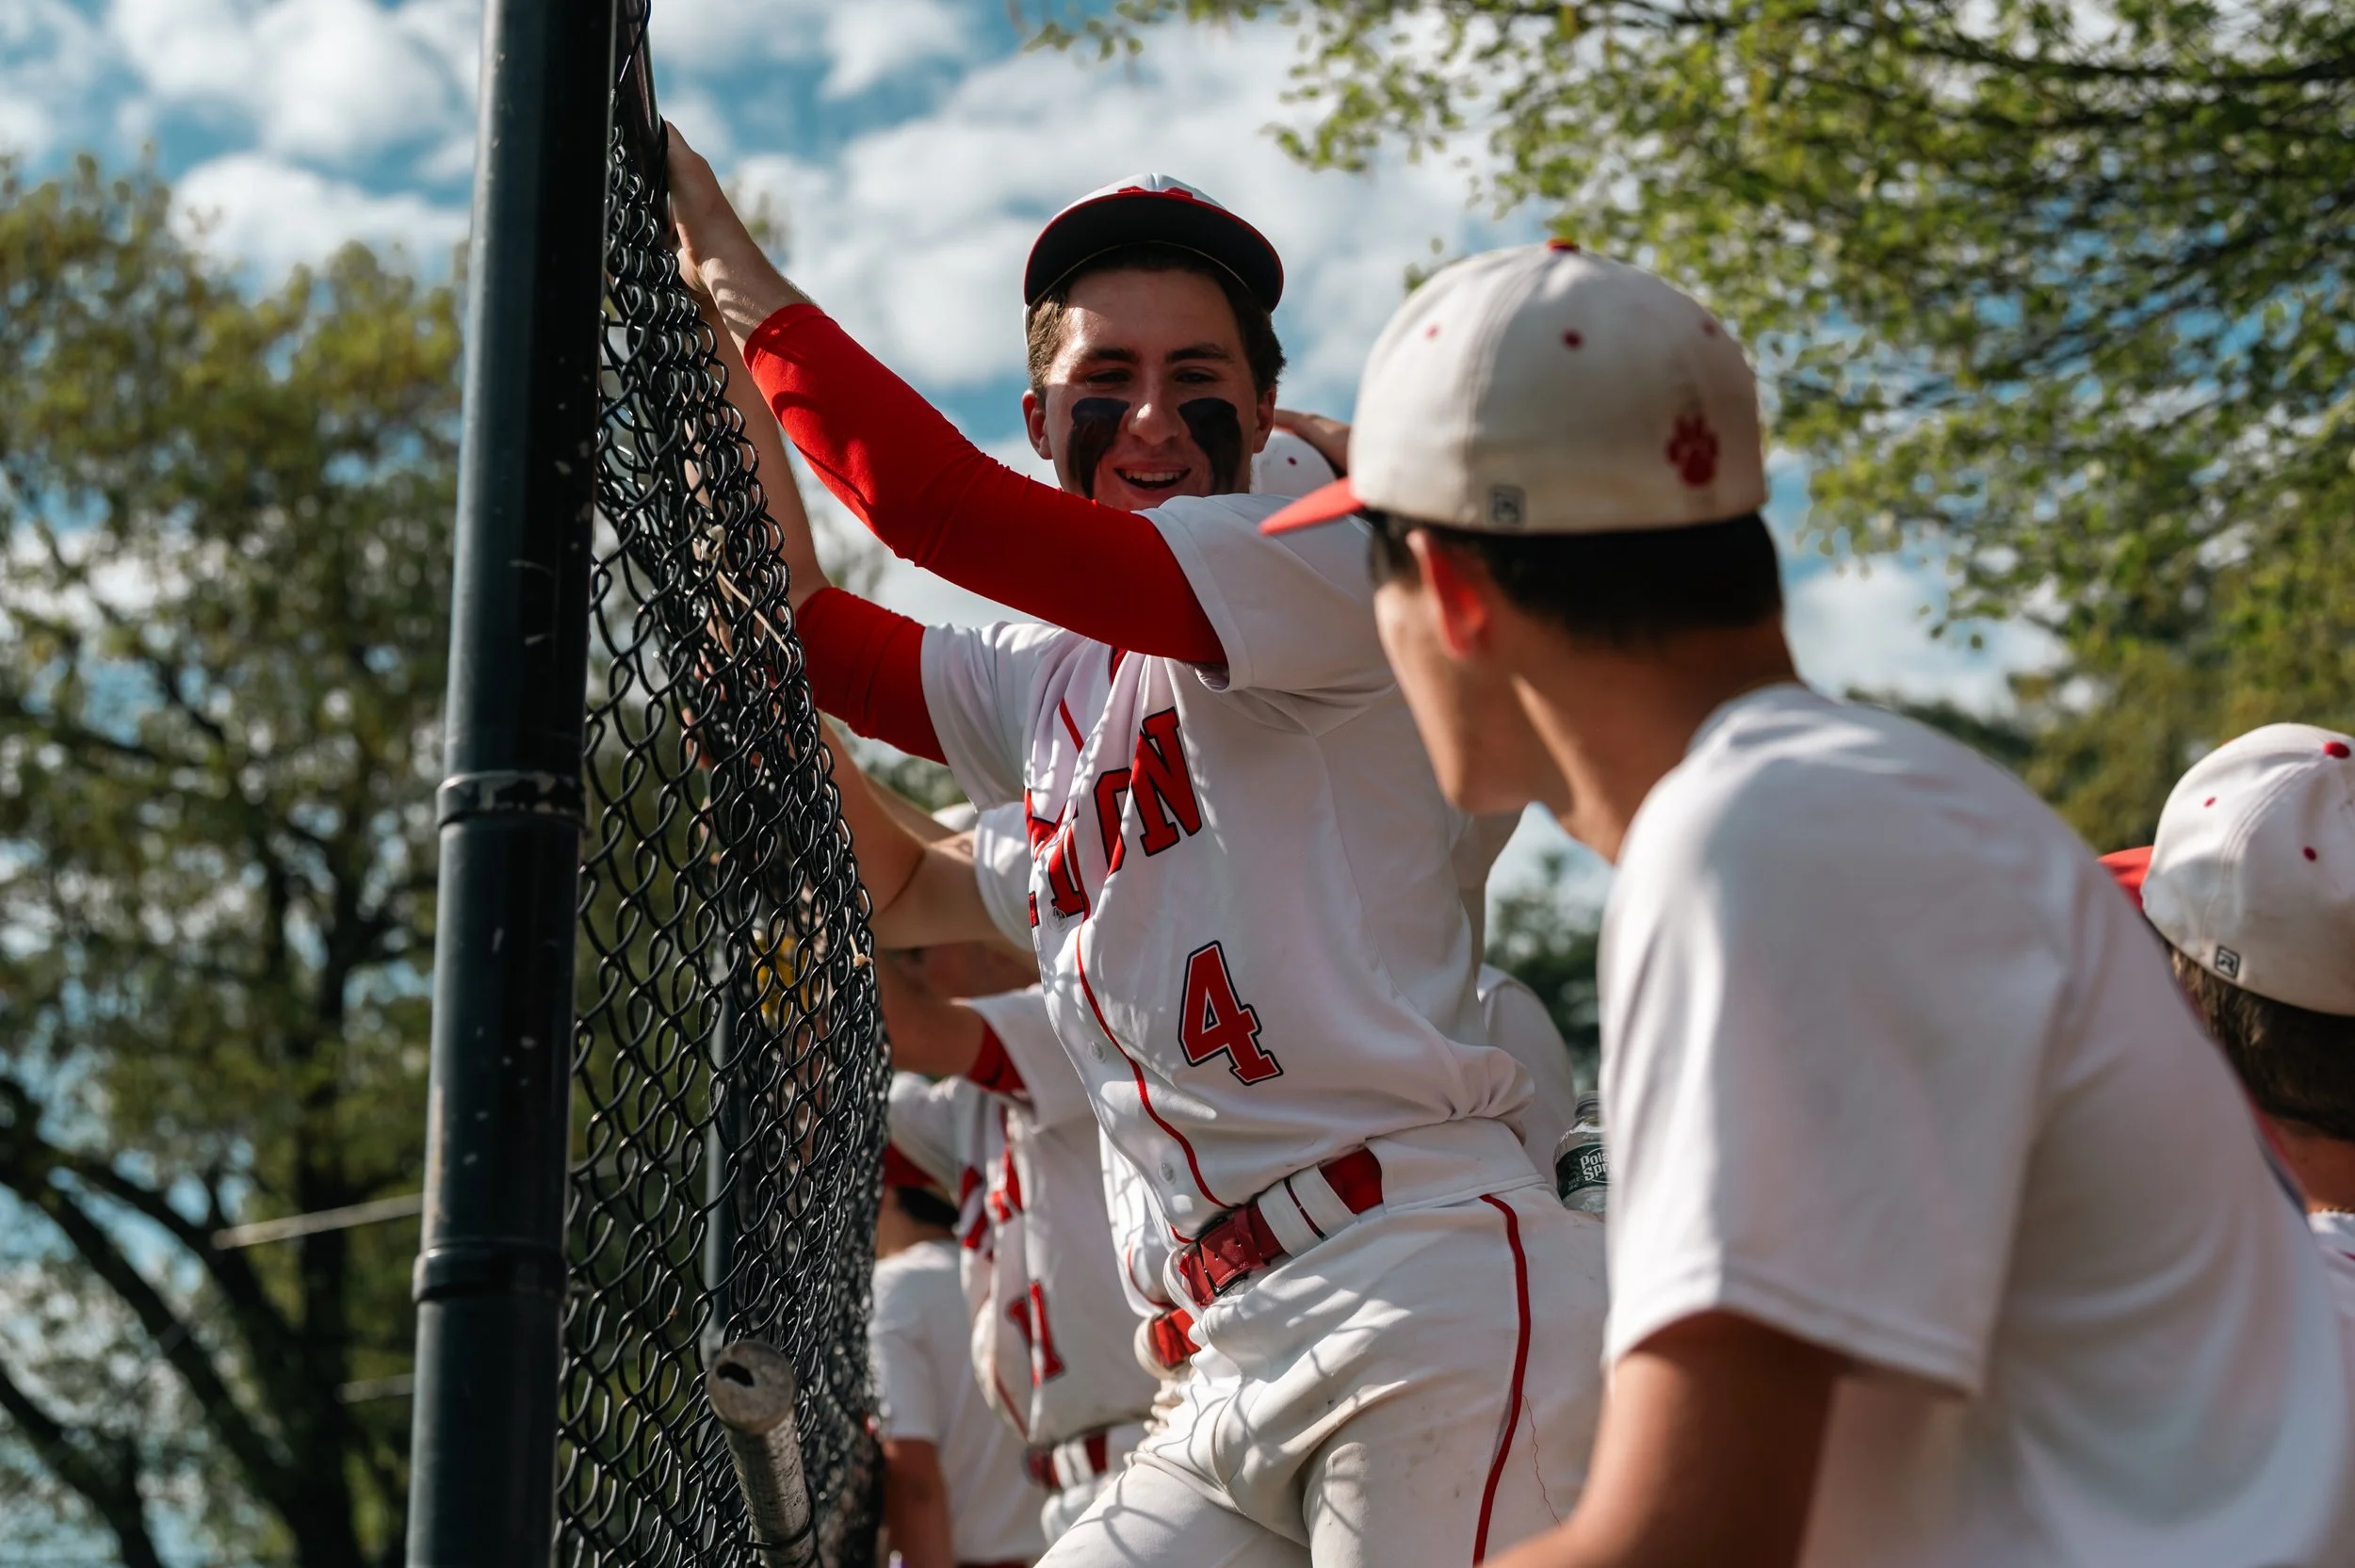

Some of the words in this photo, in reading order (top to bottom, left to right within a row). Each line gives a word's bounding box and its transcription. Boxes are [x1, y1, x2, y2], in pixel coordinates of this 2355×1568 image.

[1178, 940, 1284, 1086] 4
[1580, 1152, 1610, 1170] Pola
[1583, 1163, 1608, 1181] Spr
